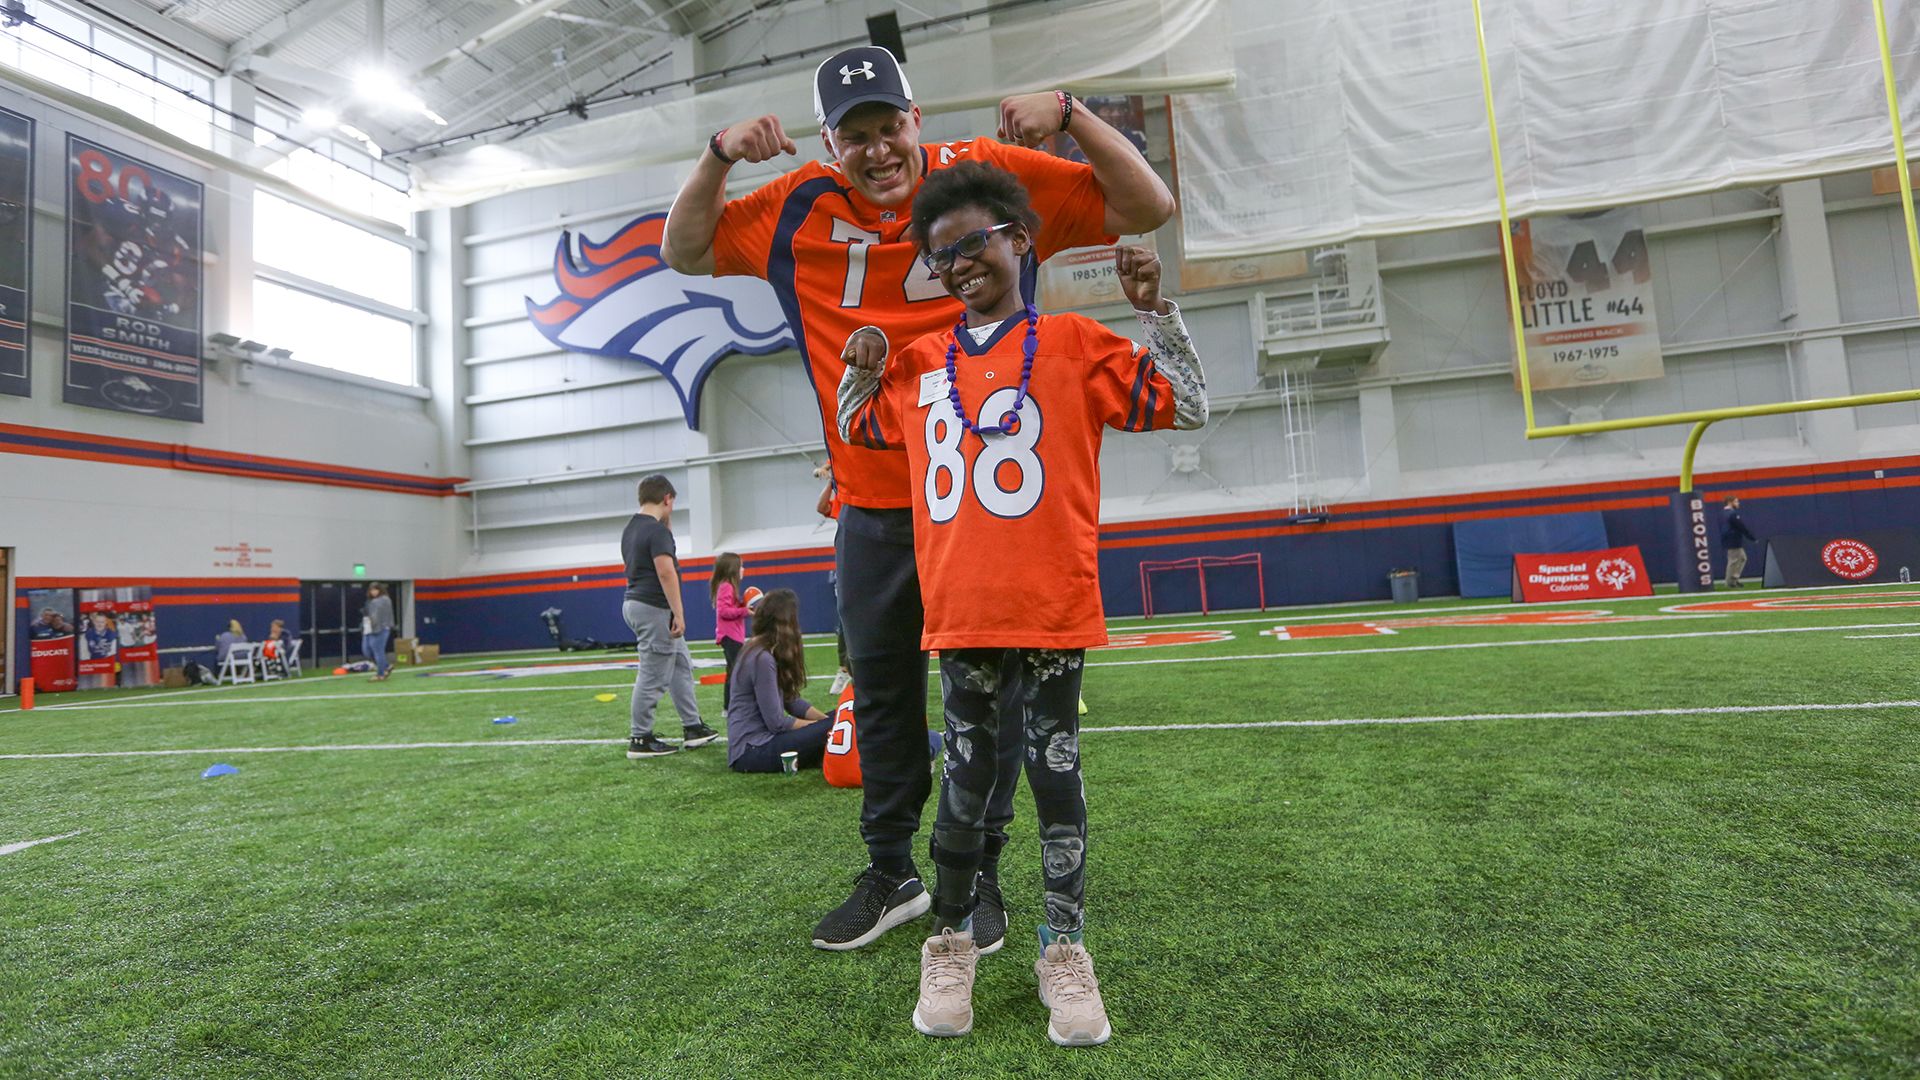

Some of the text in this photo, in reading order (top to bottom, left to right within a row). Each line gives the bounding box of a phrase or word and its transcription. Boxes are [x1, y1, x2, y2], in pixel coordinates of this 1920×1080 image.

[1073, 265, 1117, 281] 1983-199
[1520, 297, 1643, 329] LITTLE #44
[116, 316, 161, 336] ROD
[102, 327, 170, 351] SMITH
[1553, 345, 1619, 363] 1967-1975
[925, 386, 1045, 524] 88
[1690, 499, 1712, 585] BRONCOS
[1823, 540, 1875, 562] SPECIAL OLYMPICS
[1538, 562, 1588, 575] Special
[1831, 563, 1875, 578] PLAY UNIFIED
[1529, 573, 1590, 585] Olympics
[1549, 582, 1590, 593] Colorado
[31, 648, 69, 658] EDUCATE
